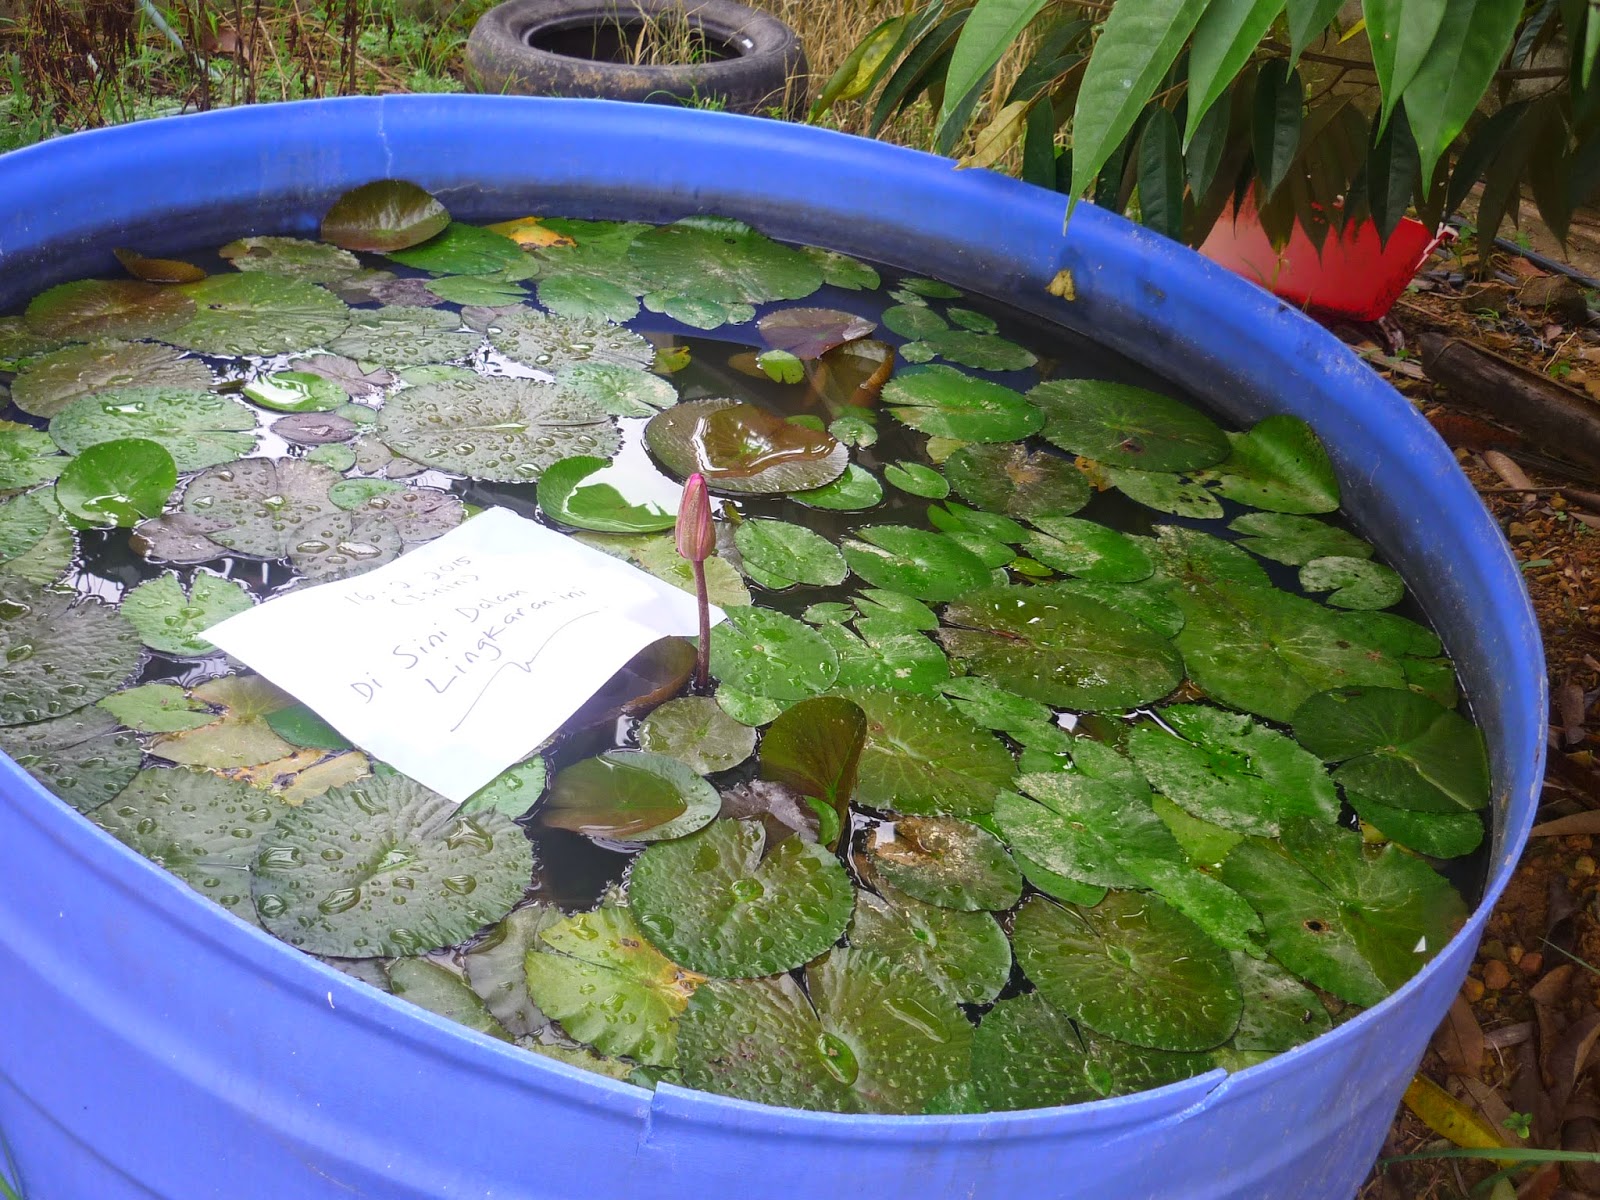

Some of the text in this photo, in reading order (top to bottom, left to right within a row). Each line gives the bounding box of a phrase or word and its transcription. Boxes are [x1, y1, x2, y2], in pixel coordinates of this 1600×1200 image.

[350, 588, 529, 704] Di Sini Dalam
